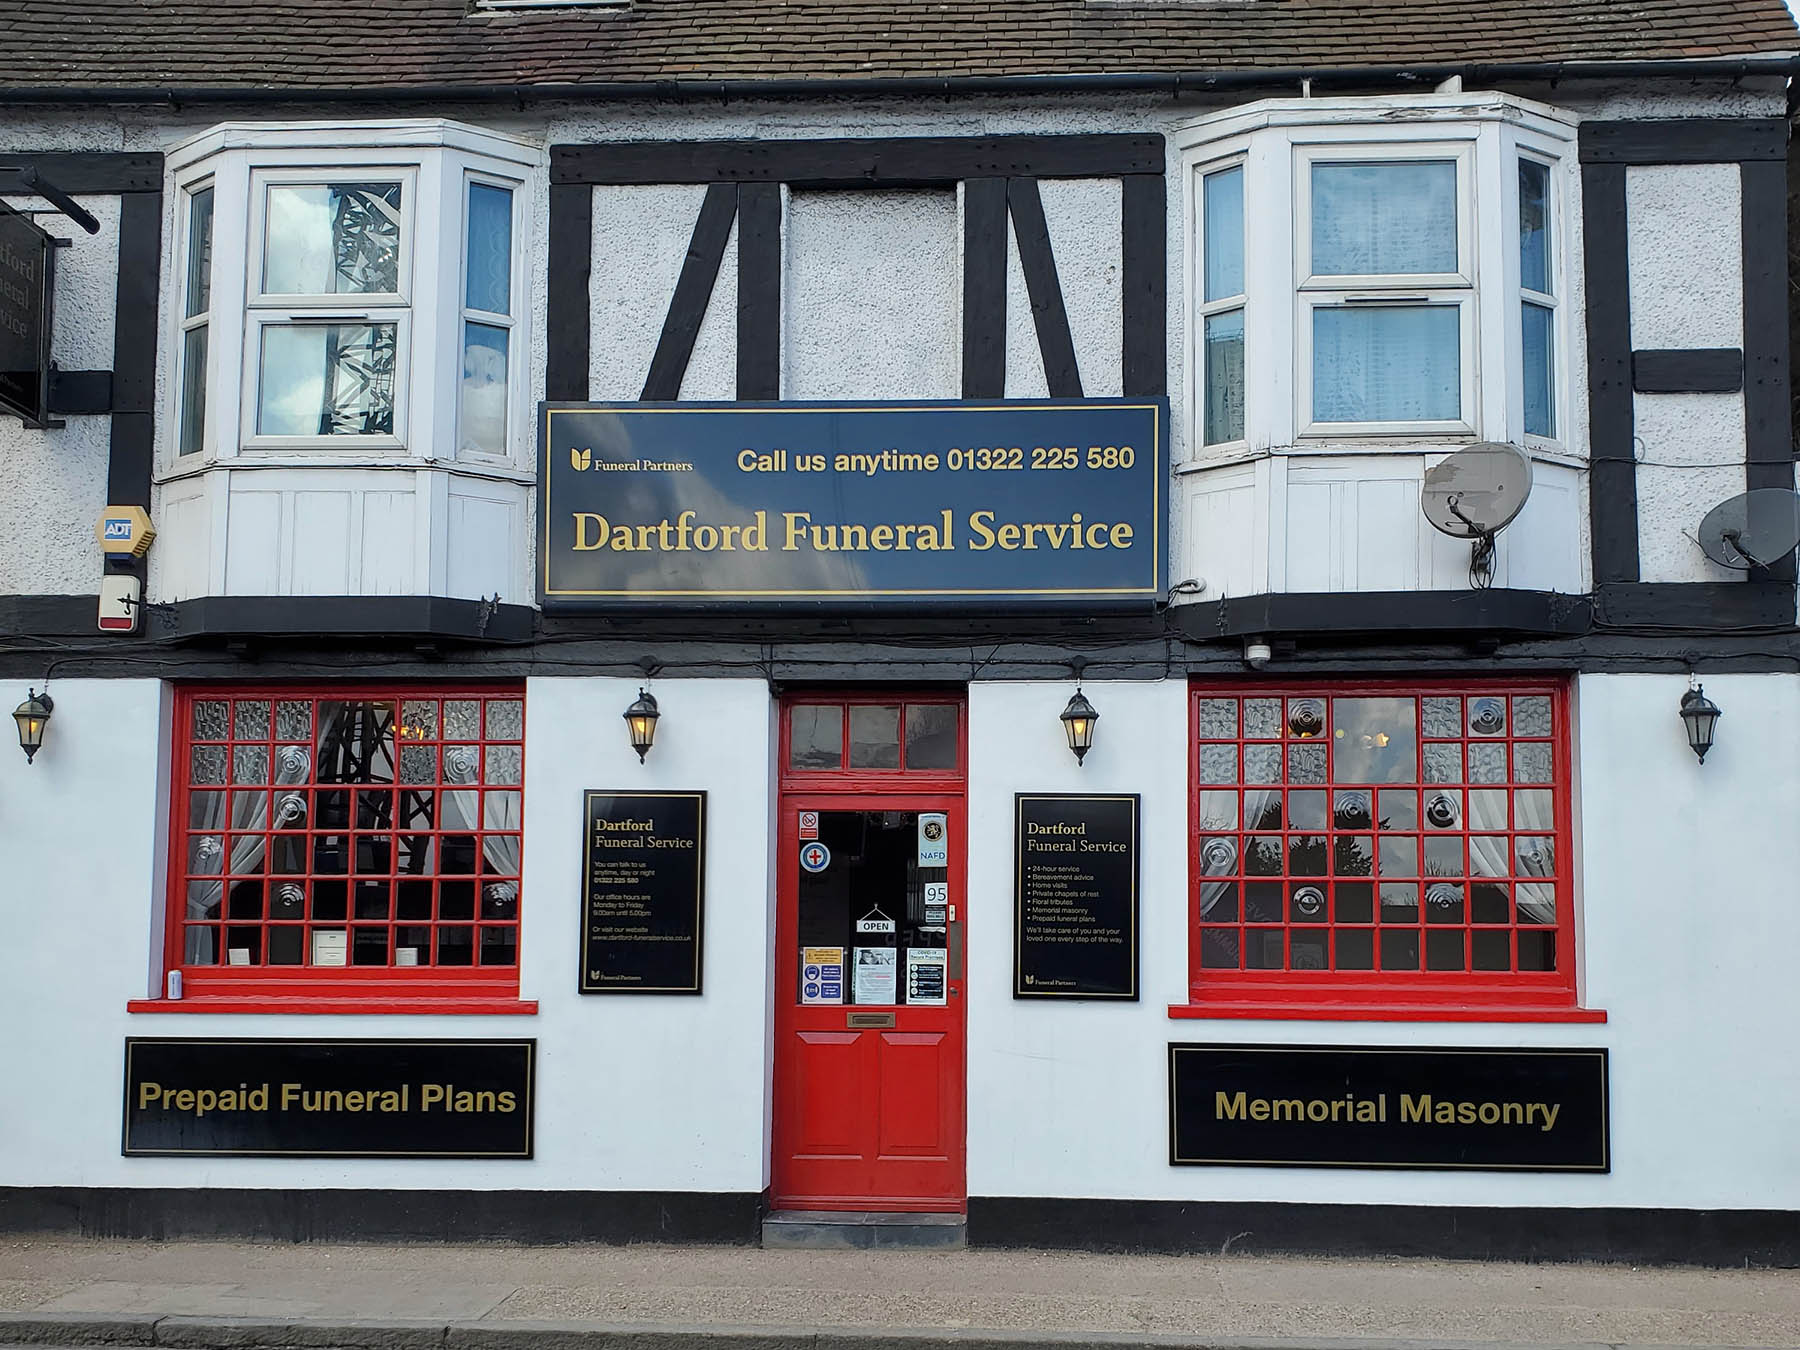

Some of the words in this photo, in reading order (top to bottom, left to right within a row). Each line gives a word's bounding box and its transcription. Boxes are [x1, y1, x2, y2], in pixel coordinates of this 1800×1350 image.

[594, 459, 641, 472] Funeral
[642, 459, 694, 473] Partners
[738, 449, 786, 473] Call
[796, 450, 827, 473] us
[834, 448, 940, 475] anytime
[947, 447, 1023, 472] 01322
[1031, 447, 1080, 470] 225
[1087, 447, 1136, 469] 580
[105, 523, 131, 536] ADT
[572, 510, 768, 553] Dartford
[782, 511, 955, 552] Funeral
[968, 510, 1134, 552] Service
[595, 819, 653, 832] Dartford
[1027, 822, 1086, 834] Dartford
[595, 836, 644, 848] Funeral
[647, 836, 694, 849] Service
[1027, 839, 1076, 852] Funeral
[1080, 839, 1127, 852] Service
[920, 851, 946, 860] NAFD
[927, 887, 946, 902] 95
[863, 922, 889, 931] OPEN
[1075, 936, 1089, 944] step
[138, 1082, 269, 1117] Prepaid
[281, 1083, 409, 1112] Funeral
[421, 1084, 517, 1113] Plans
[1215, 1092, 1386, 1121] Memorial
[1400, 1094, 1560, 1131] Masonry
